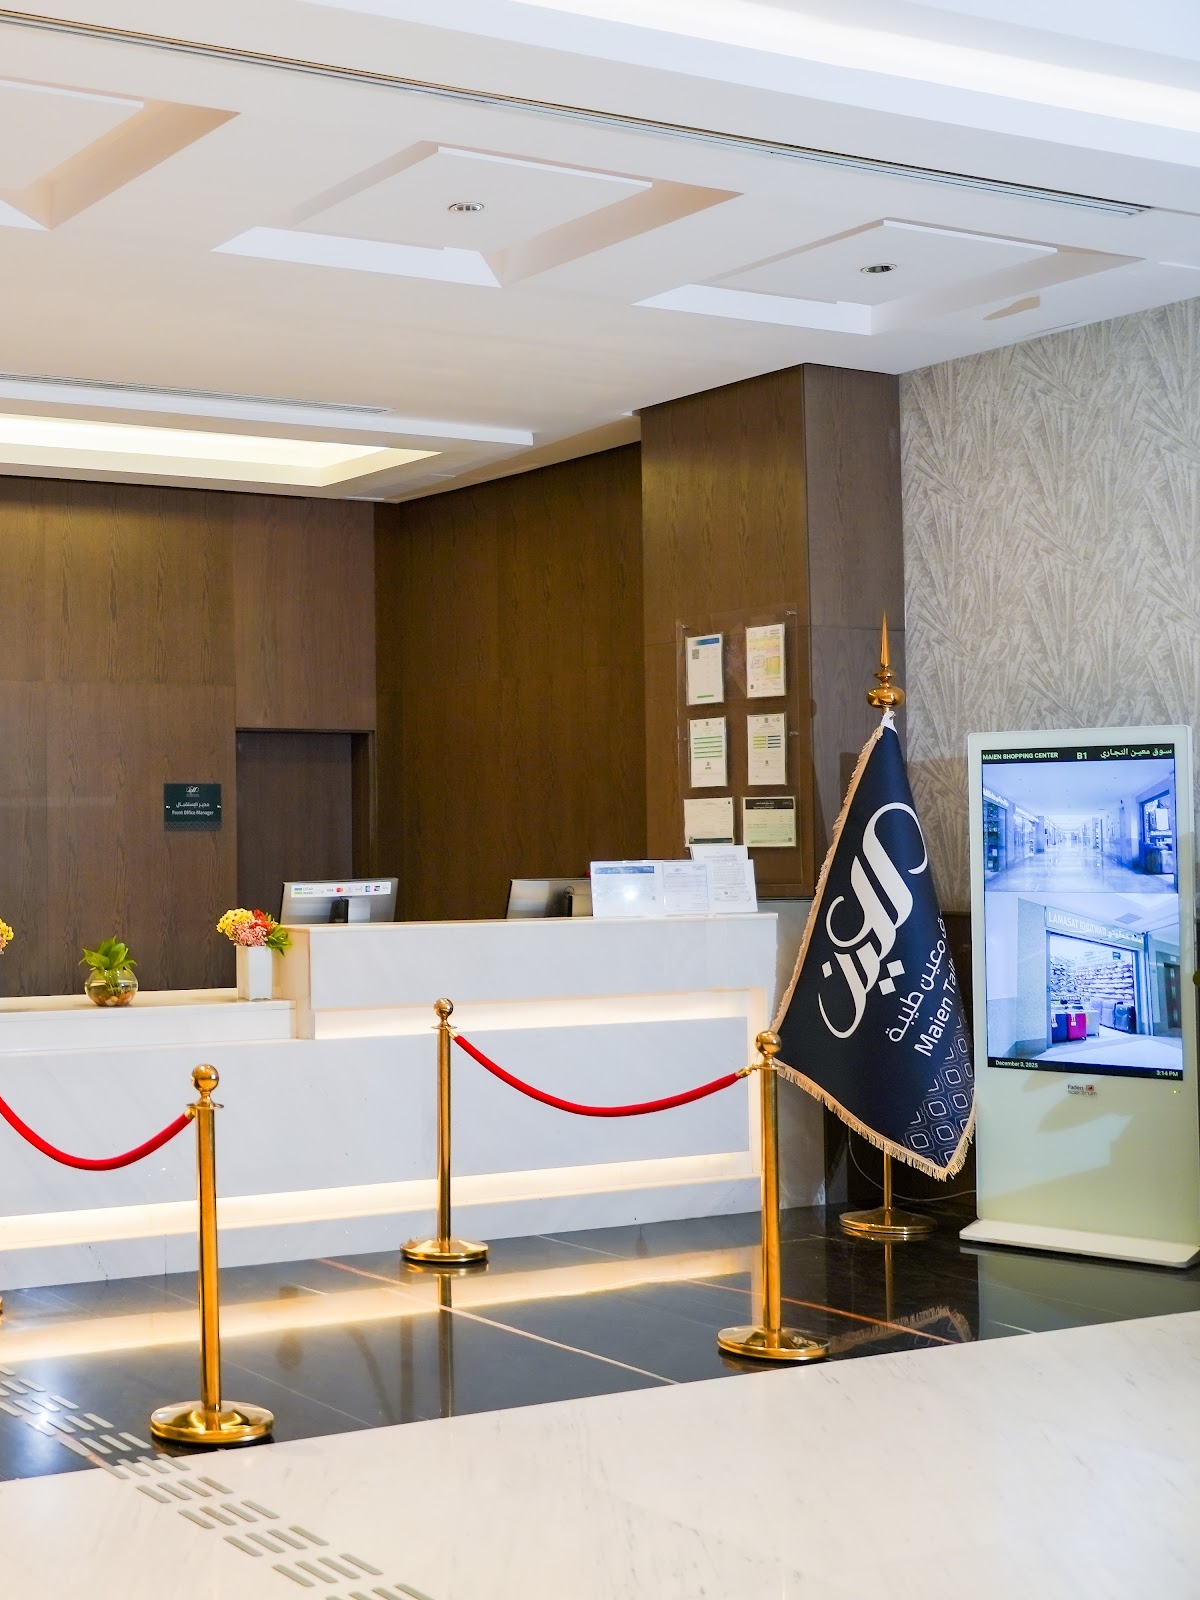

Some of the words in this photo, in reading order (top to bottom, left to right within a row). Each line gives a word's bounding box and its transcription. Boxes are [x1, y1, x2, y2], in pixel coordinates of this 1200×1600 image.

[1002, 752, 1034, 760] SHOPPING
[1034, 751, 1059, 759] CENTER
[1076, 751, 1088, 760] B1
[1100, 747, 1129, 759] التجاري
[1130, 749, 1151, 757] معين
[1152, 748, 1173, 757] سوق
[920, 940, 946, 991] معين
[885, 991, 925, 1043] طيبة
[913, 996, 954, 1057] Maien
[995, 1059, 1020, 1067] December
